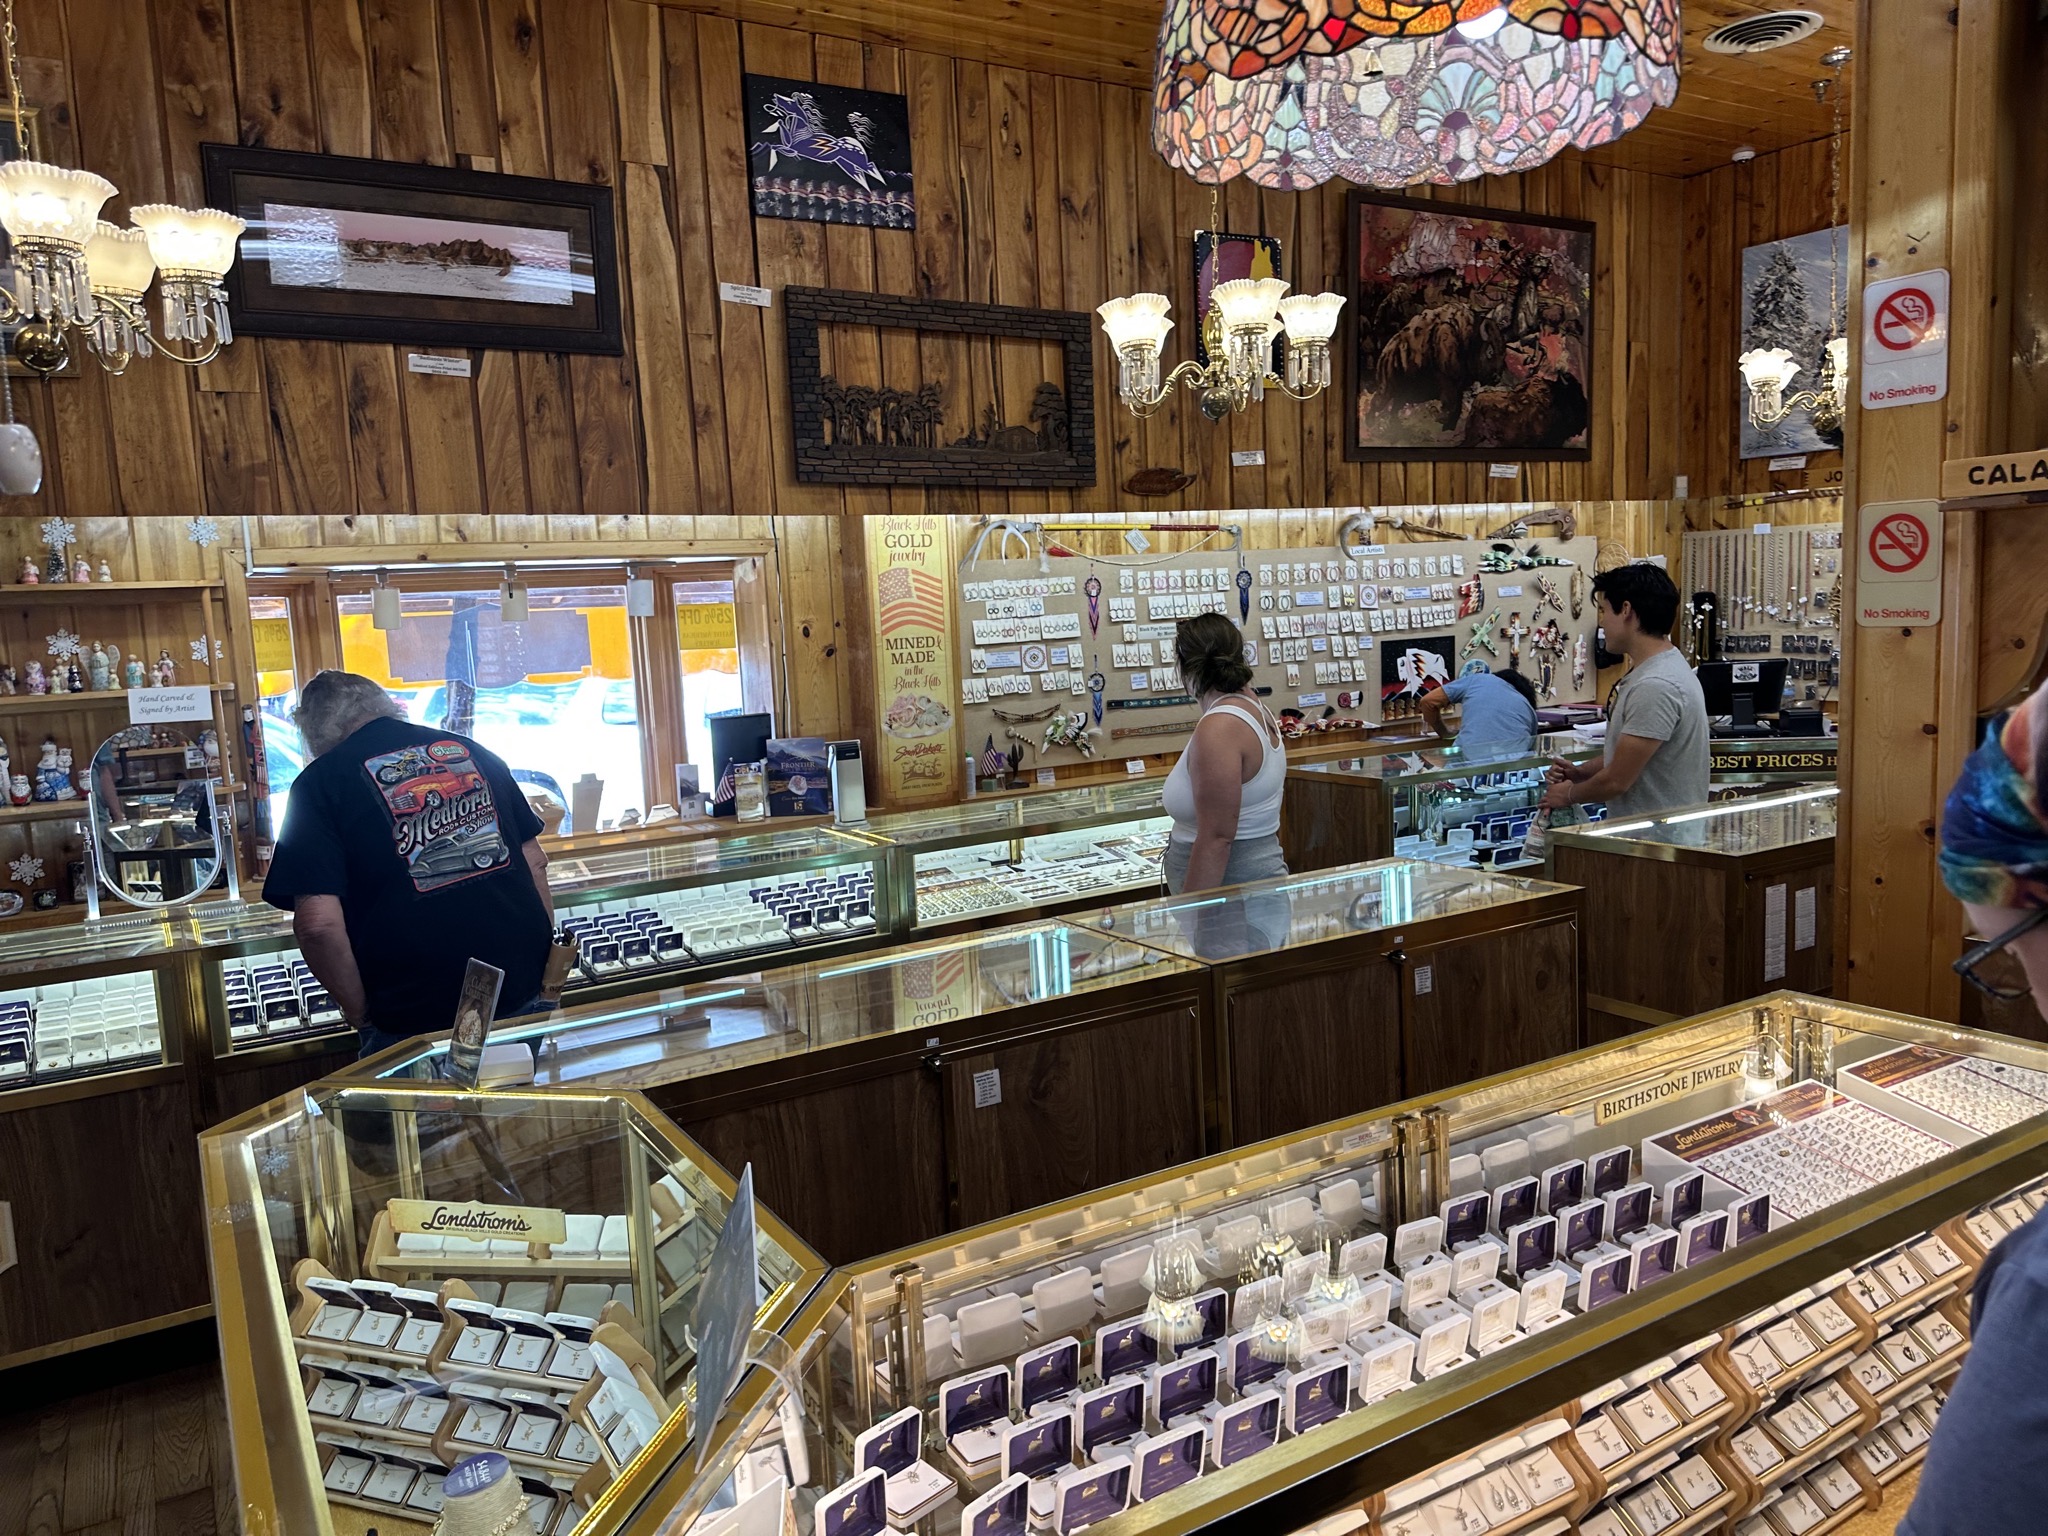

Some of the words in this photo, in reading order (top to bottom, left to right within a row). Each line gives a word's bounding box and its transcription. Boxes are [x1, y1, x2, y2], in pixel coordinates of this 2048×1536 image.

[1869, 391, 1885, 401] No
[1887, 384, 1936, 399] Smoking
[880, 515, 912, 535] Black
[884, 534, 933, 548] GOLD
[888, 549, 926, 567] jewelry
[1351, 547, 1366, 555] Local
[1366, 546, 1384, 554] Artists
[1864, 609, 1880, 619] No
[1881, 608, 1930, 620] Smoking
[885, 636, 935, 651] MINED
[891, 651, 936, 665] MADE
[904, 666, 912, 676] in
[913, 665, 924, 675] the
[894, 676, 920, 693] Black
[923, 673, 942, 690] Hills
[138, 694, 159, 703] Hand
[160, 693, 185, 703] Carved
[139, 705, 164, 715] Signed
[164, 705, 173, 714] by
[174, 705, 196, 713] Artist
[780, 761, 816, 769] FRONTIER
[1756, 754, 1823, 768] PRICES
[394, 780, 493, 856] Medford
[459, 805, 494, 825] CUSTOM
[465, 812, 495, 835] Show
[1602, 1076, 1688, 1119] BIRTHSTONE
[1691, 1058, 1744, 1092] JEWELRY
[420, 1206, 532, 1231] Landstrom's
